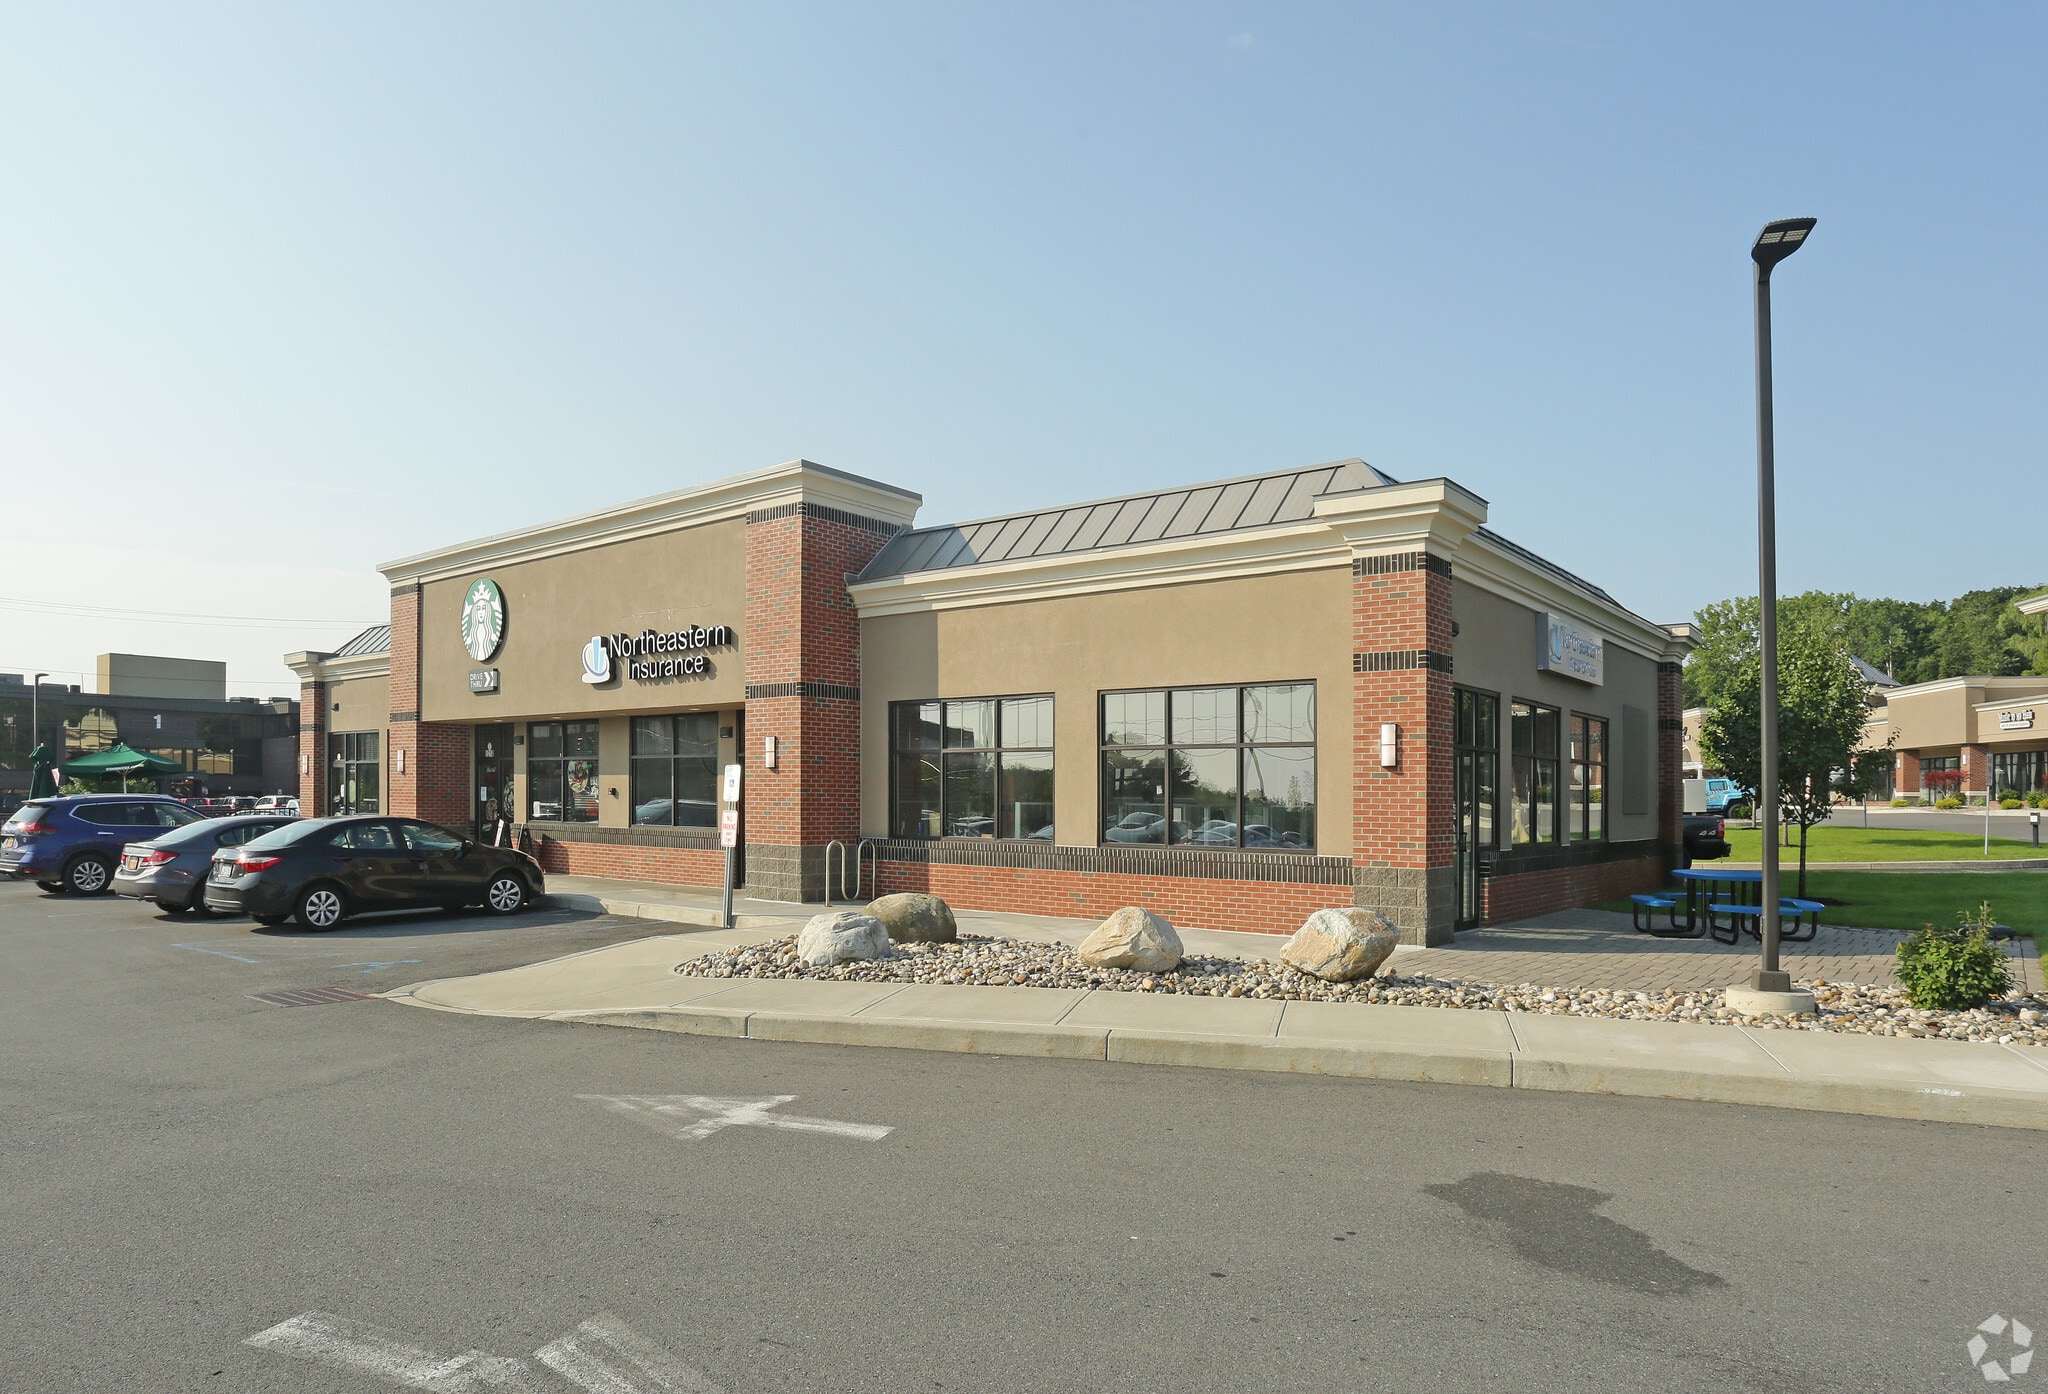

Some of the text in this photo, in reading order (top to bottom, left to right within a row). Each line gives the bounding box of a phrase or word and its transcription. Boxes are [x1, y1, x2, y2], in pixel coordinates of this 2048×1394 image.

[609, 624, 727, 658] Northeastern
[627, 654, 704, 680] Insurance
[469, 672, 483, 681] DRIVE
[469, 680, 483, 688] THRU
[153, 714, 162, 729] 1
